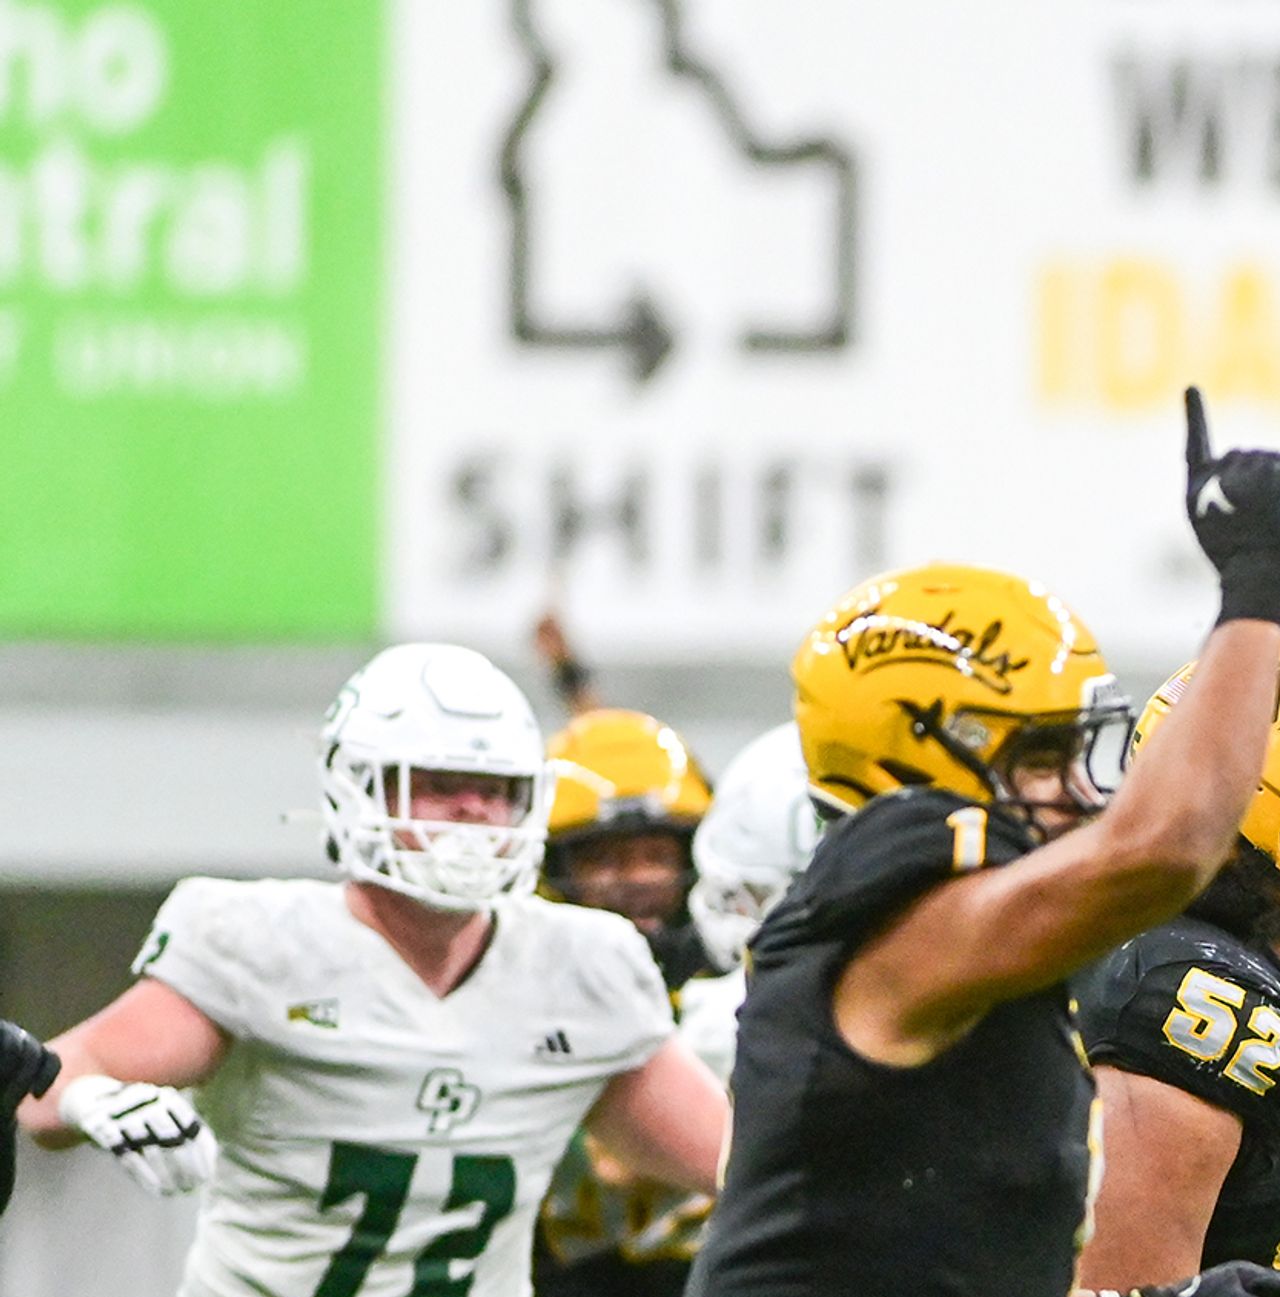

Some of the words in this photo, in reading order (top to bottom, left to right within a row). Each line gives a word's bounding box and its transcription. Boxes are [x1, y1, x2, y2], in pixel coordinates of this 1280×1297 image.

[446, 448, 908, 588] SHIFT
[835, 609, 1030, 695] Vandals
[944, 806, 988, 872] 1
